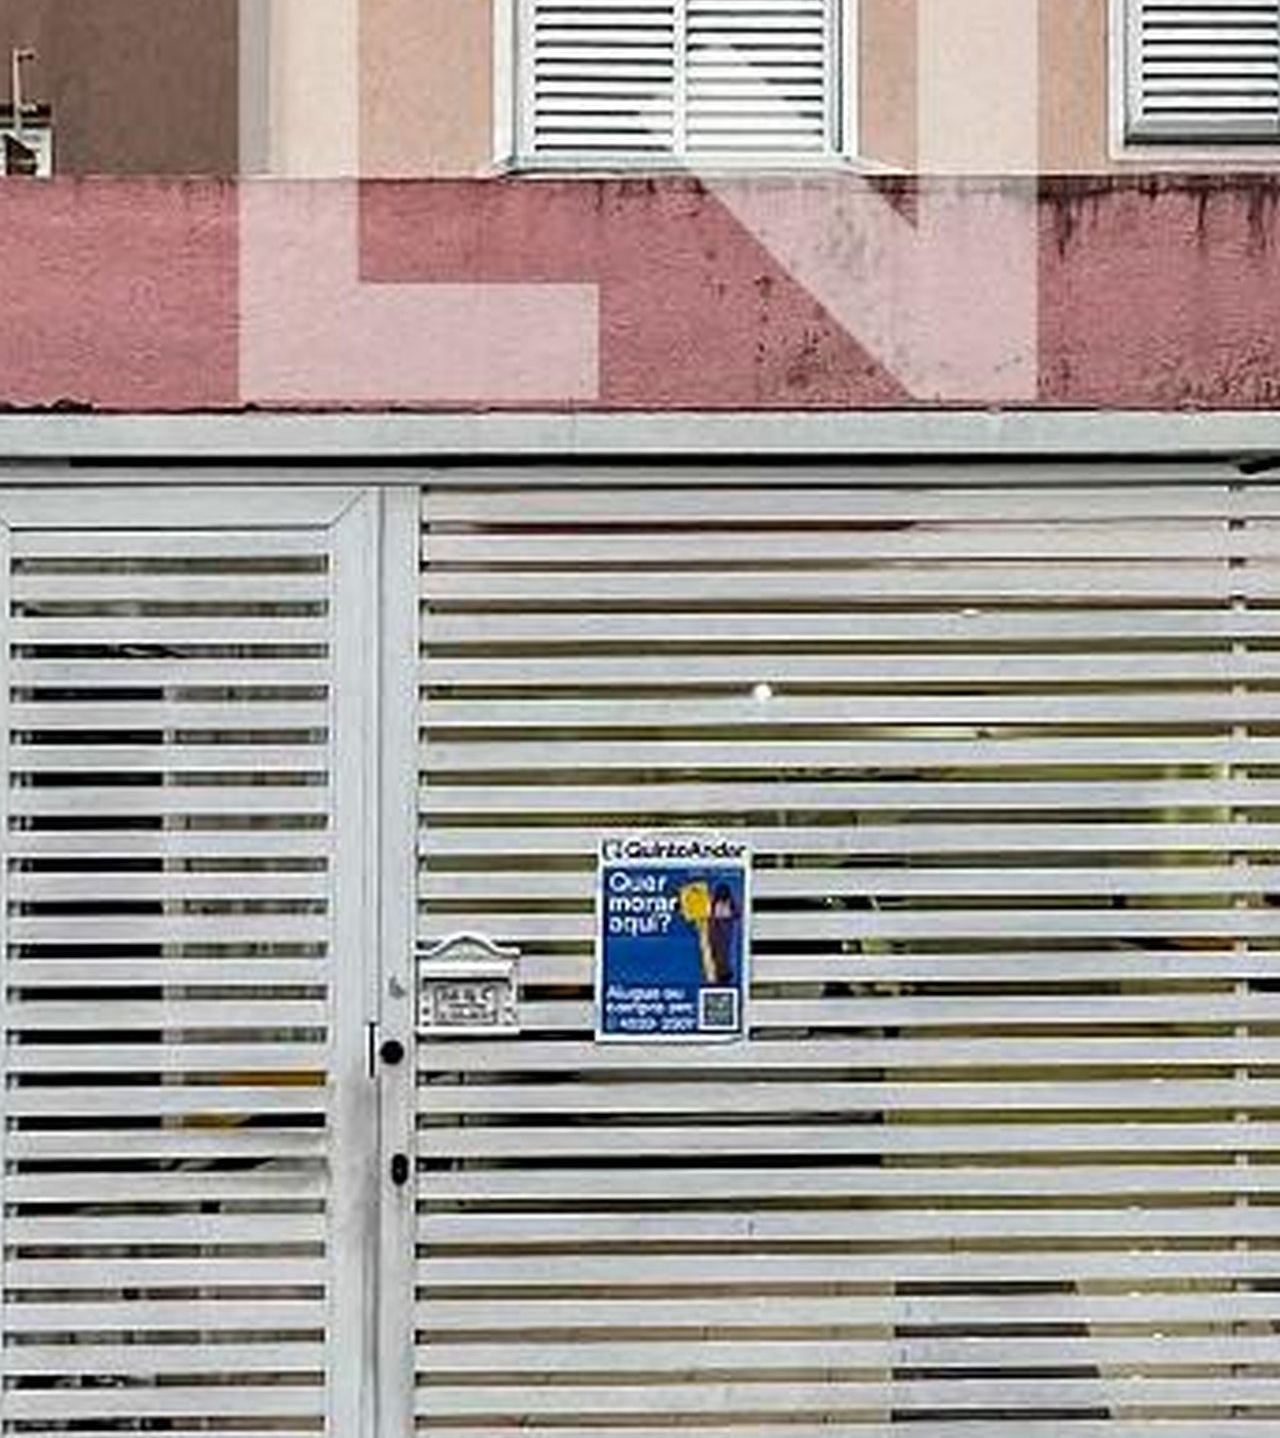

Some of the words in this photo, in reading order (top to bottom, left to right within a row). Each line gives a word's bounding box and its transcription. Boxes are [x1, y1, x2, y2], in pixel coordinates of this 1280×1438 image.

[608, 871, 668, 893] Quer
[608, 895, 679, 912] morar
[608, 913, 671, 937] aqui?
